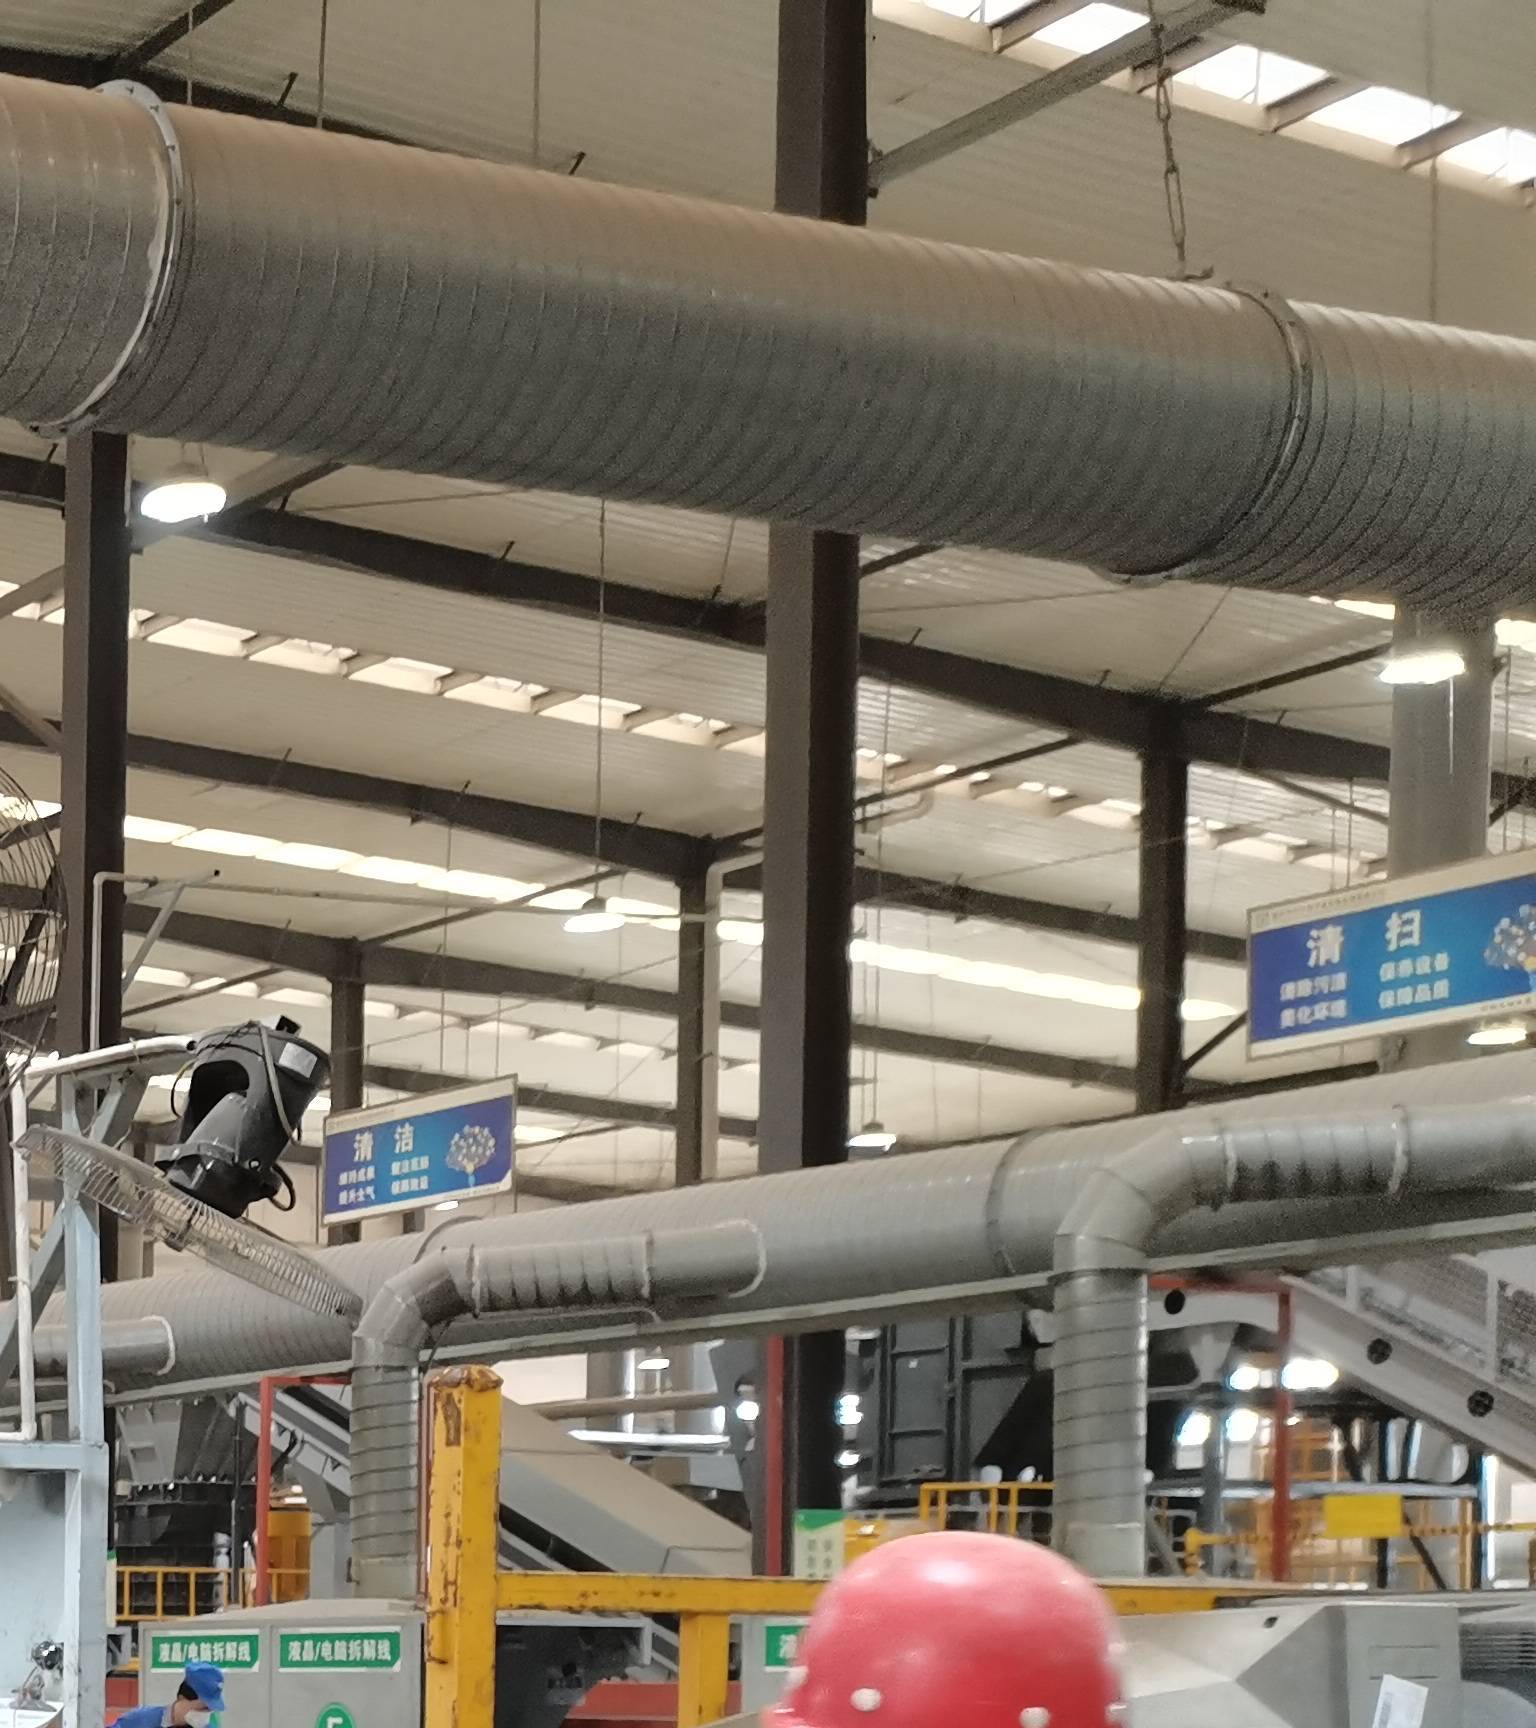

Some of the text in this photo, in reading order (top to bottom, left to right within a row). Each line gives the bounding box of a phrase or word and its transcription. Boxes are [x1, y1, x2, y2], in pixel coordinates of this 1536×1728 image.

[288, 1639, 391, 1662] 液晶/电脑拆解线
